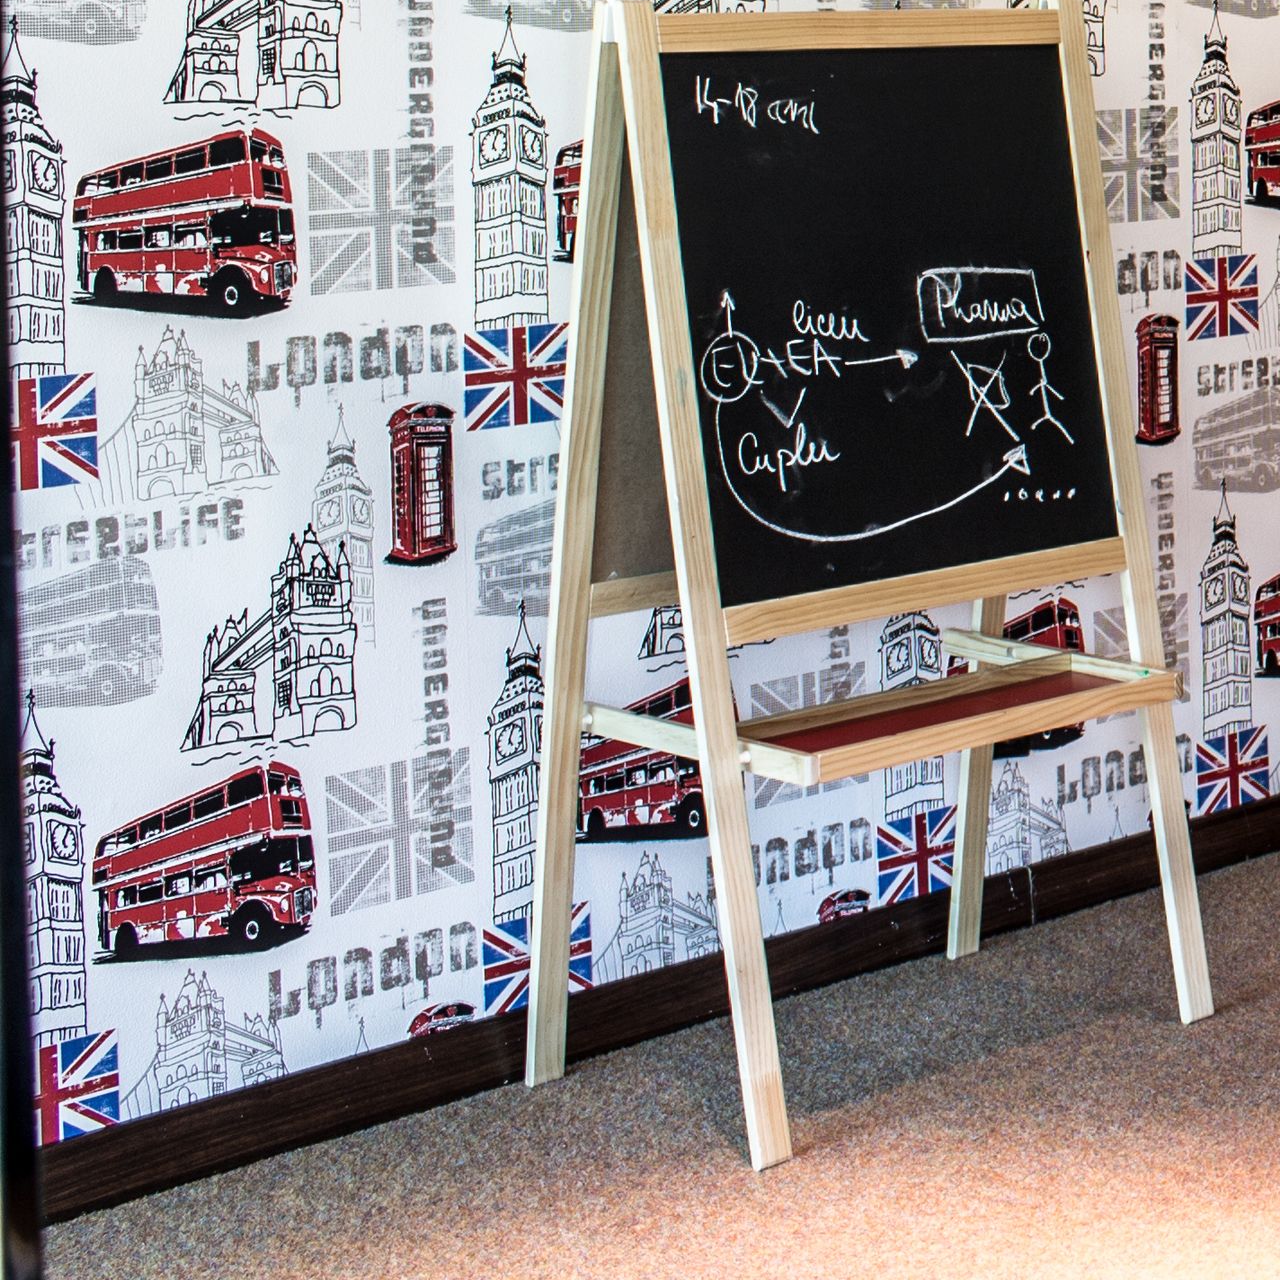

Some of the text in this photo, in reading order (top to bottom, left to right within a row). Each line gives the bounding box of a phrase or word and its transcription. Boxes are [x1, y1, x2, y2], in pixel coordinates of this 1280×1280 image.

[246, 320, 458, 392] London
[1057, 723, 1193, 804] Londn
[707, 817, 873, 892] ndon
[268, 916, 477, 1021] London
